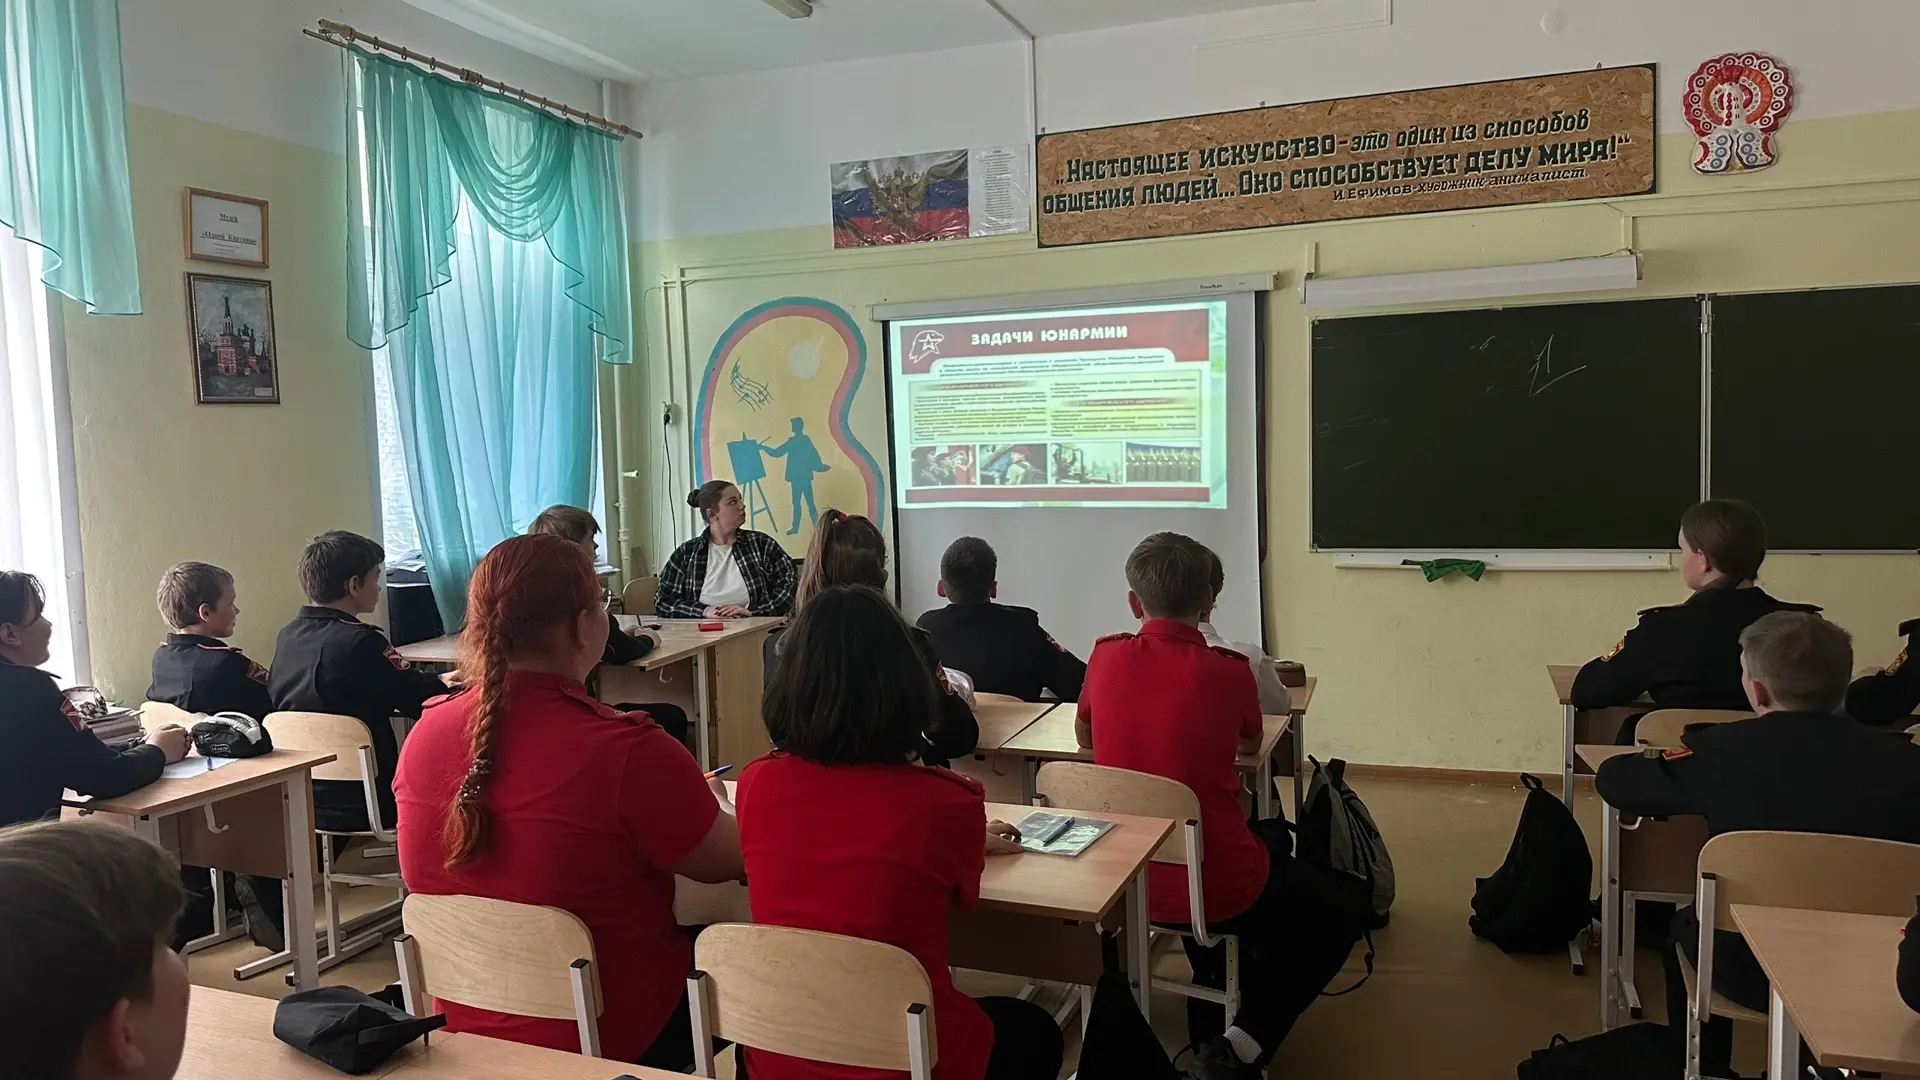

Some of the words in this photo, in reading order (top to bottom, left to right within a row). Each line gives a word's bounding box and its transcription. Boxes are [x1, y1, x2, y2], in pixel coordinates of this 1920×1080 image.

[1396, 125, 1447, 148] один
[1451, 123, 1477, 142] из
[1483, 108, 1589, 139] способов
[1043, 187, 1135, 215] ОБЩЕНИЯ
[1290, 153, 1459, 191] СПОСОБСТВУЕТ
[1464, 147, 1530, 176] ДЕЛУ
[971, 330, 1033, 346] ЗАДАЧИ
[1041, 325, 1128, 342] ЮНАРМИИ
